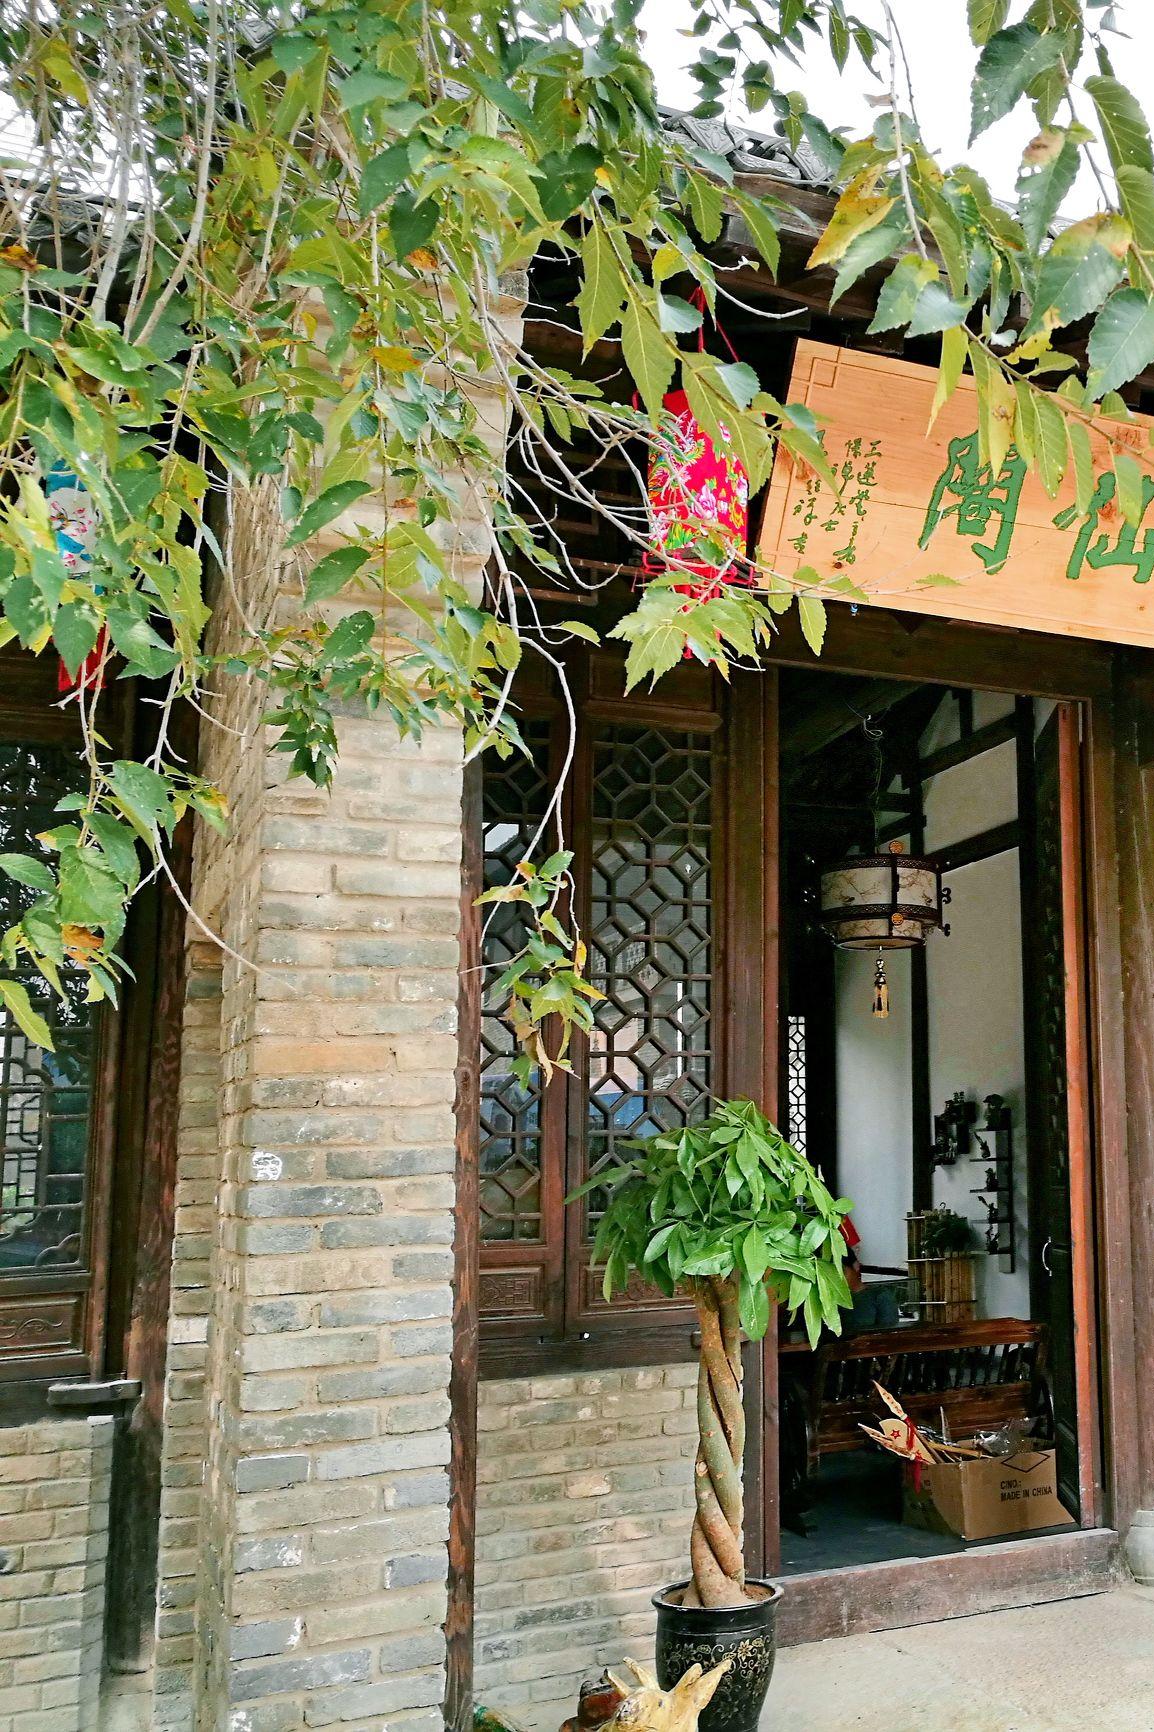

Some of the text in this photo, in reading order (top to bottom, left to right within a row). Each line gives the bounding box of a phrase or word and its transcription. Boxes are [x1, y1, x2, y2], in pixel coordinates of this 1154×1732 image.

[1000, 1486, 1052, 1501] MADE IN CHINA
